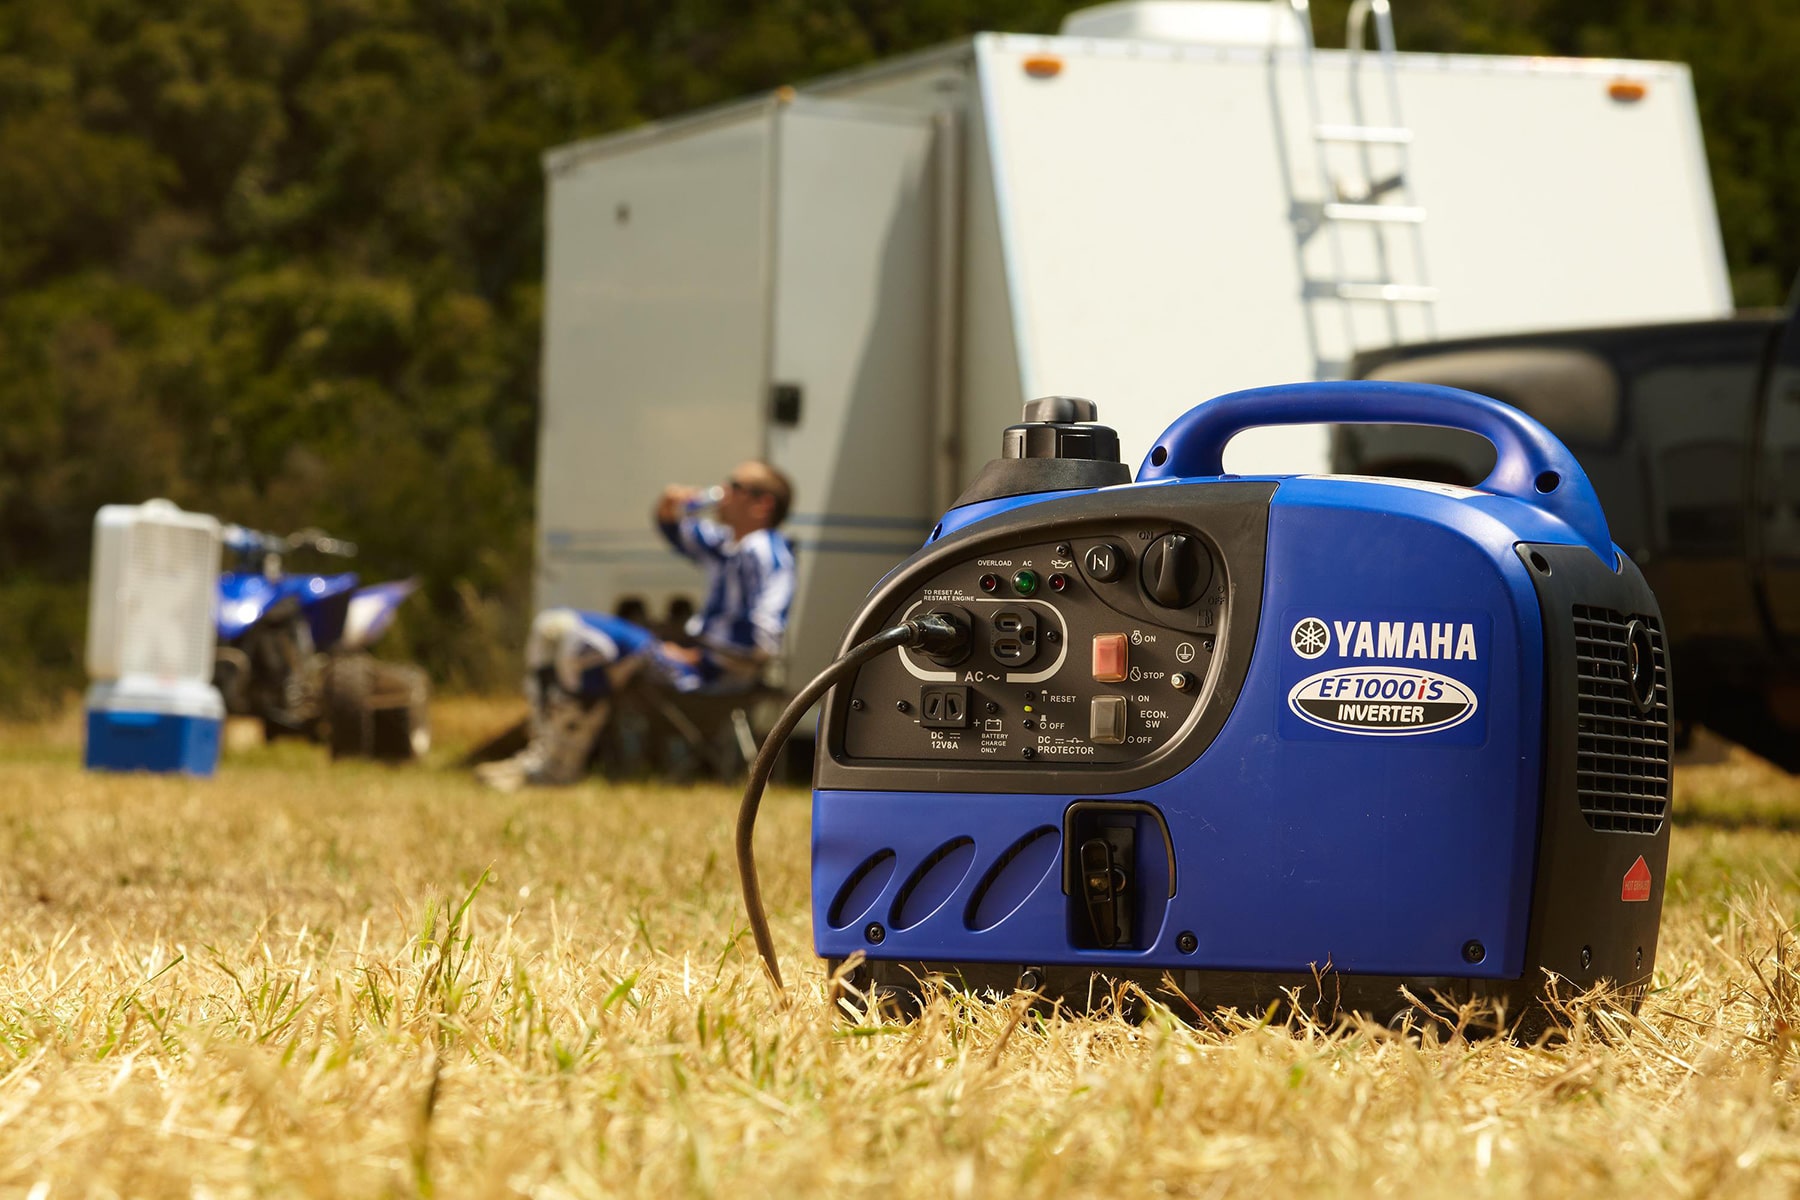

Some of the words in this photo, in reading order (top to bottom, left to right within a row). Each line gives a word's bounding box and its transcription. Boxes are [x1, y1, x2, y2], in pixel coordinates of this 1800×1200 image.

[1137, 531, 1153, 540] ON
[1144, 635, 1157, 643] ON
[1333, 620, 1478, 661] YAMAHA
[964, 671, 984, 682] AC
[1143, 672, 1165, 680] STOP
[1319, 678, 1444, 701] EF1000iS
[1140, 710, 1169, 719] ECON.
[1337, 704, 1425, 723] INVERTER
[1049, 722, 1065, 730] OFF
[1145, 720, 1161, 729] SW
[930, 731, 944, 739] DC
[1037, 736, 1051, 744] DC
[1136, 736, 1153, 744] OFF
[931, 741, 959, 749] 12V8A
[1037, 746, 1094, 755] PROTECTOR
